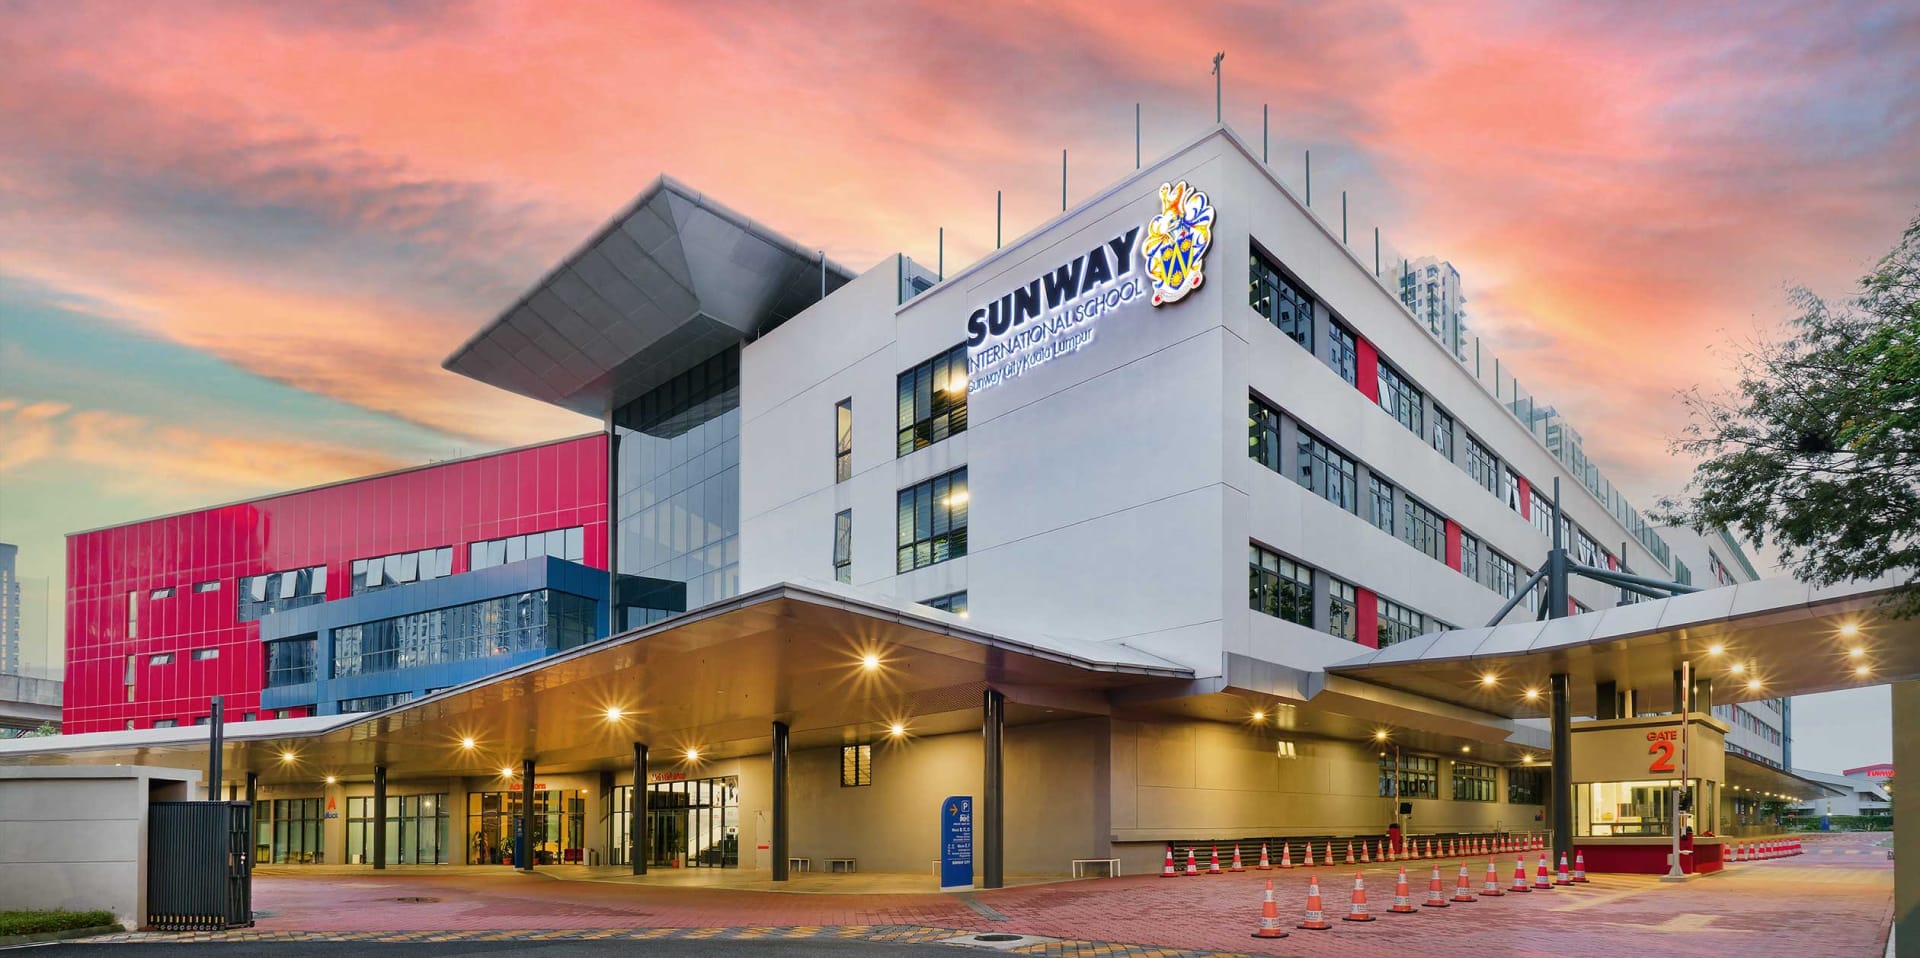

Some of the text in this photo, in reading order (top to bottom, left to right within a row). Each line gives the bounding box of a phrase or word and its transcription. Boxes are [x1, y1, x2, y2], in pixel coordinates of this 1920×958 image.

[967, 226, 1140, 348] SUNWAY
[967, 278, 1143, 374] INTERNATIONAL SCHOOL
[967, 328, 1093, 393] Sunway City Kuala Lumpur
[1647, 730, 1677, 741] GATE
[1648, 740, 1675, 773] 2
[327, 795, 337, 810] A
